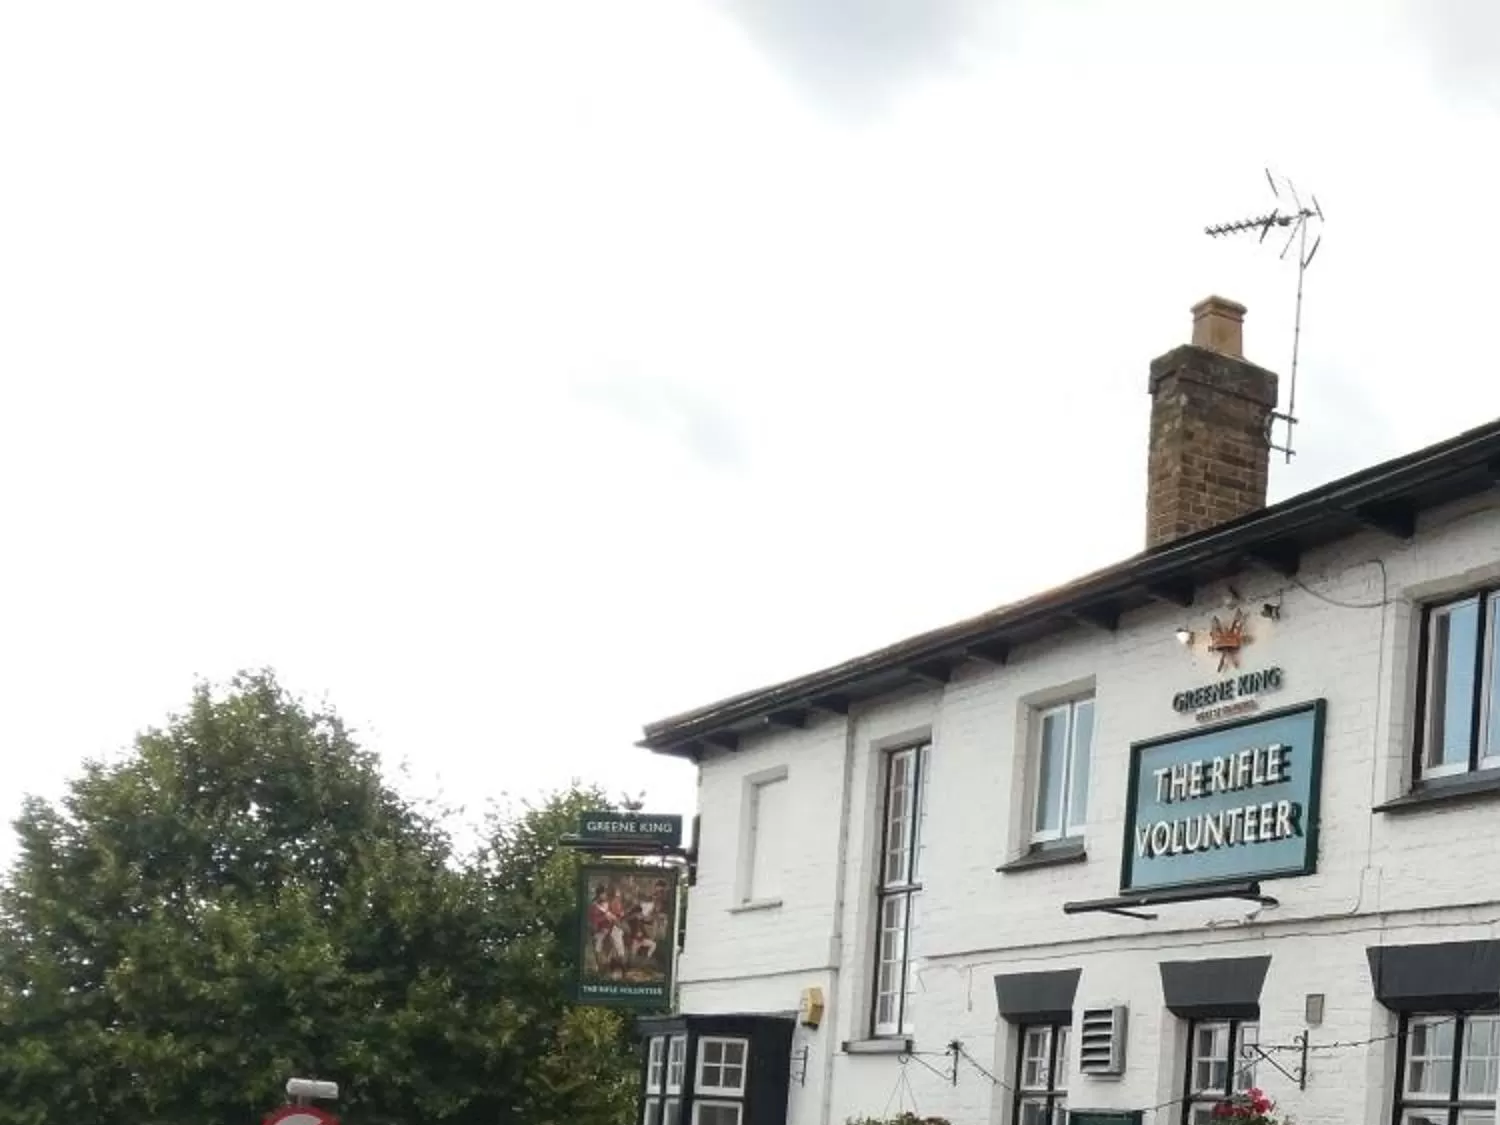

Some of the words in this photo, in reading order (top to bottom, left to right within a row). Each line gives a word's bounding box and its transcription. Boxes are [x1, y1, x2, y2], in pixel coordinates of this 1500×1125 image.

[1172, 679, 1236, 713] GREENE
[1237, 666, 1284, 697] KING
[1153, 759, 1208, 803] THE
[1211, 743, 1287, 793] RIFLE
[587, 821, 637, 833] GREENE
[640, 823, 673, 833] KING
[1136, 799, 1297, 857] VOLUNTEER
